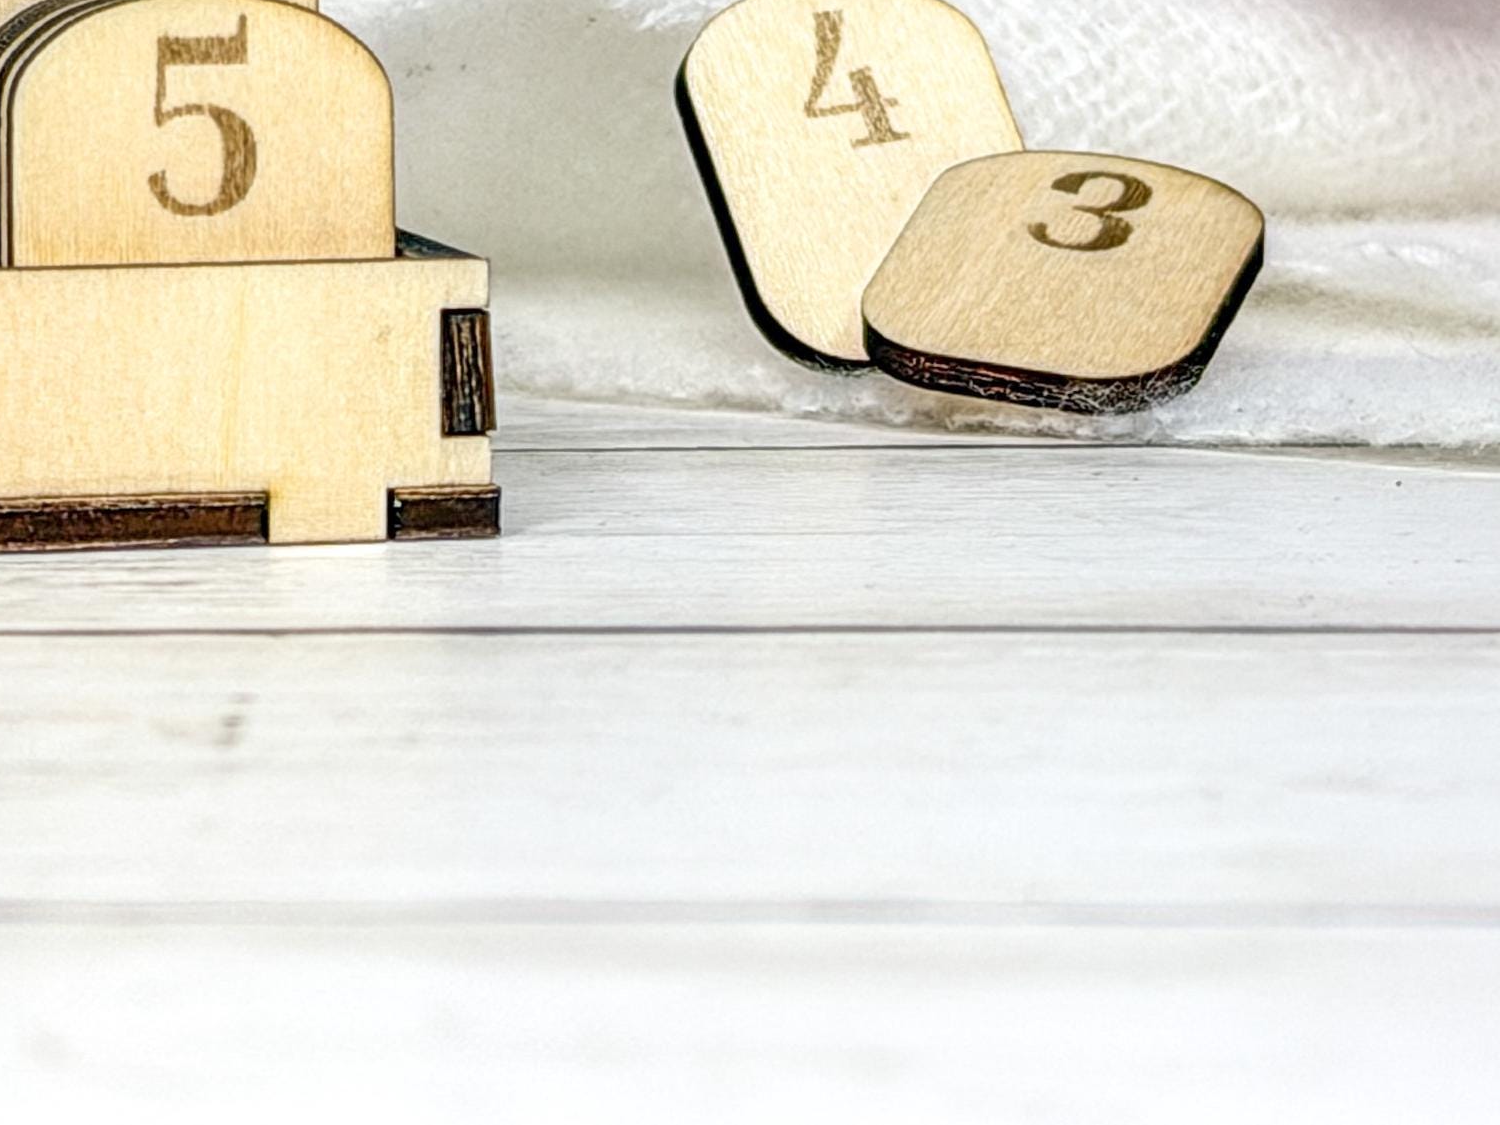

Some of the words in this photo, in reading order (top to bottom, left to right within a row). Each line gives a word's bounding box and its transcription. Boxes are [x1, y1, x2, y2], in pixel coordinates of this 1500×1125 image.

[147, 14, 259, 217] 5
[803, 9, 911, 149] 4
[1027, 170, 1153, 252] 3
